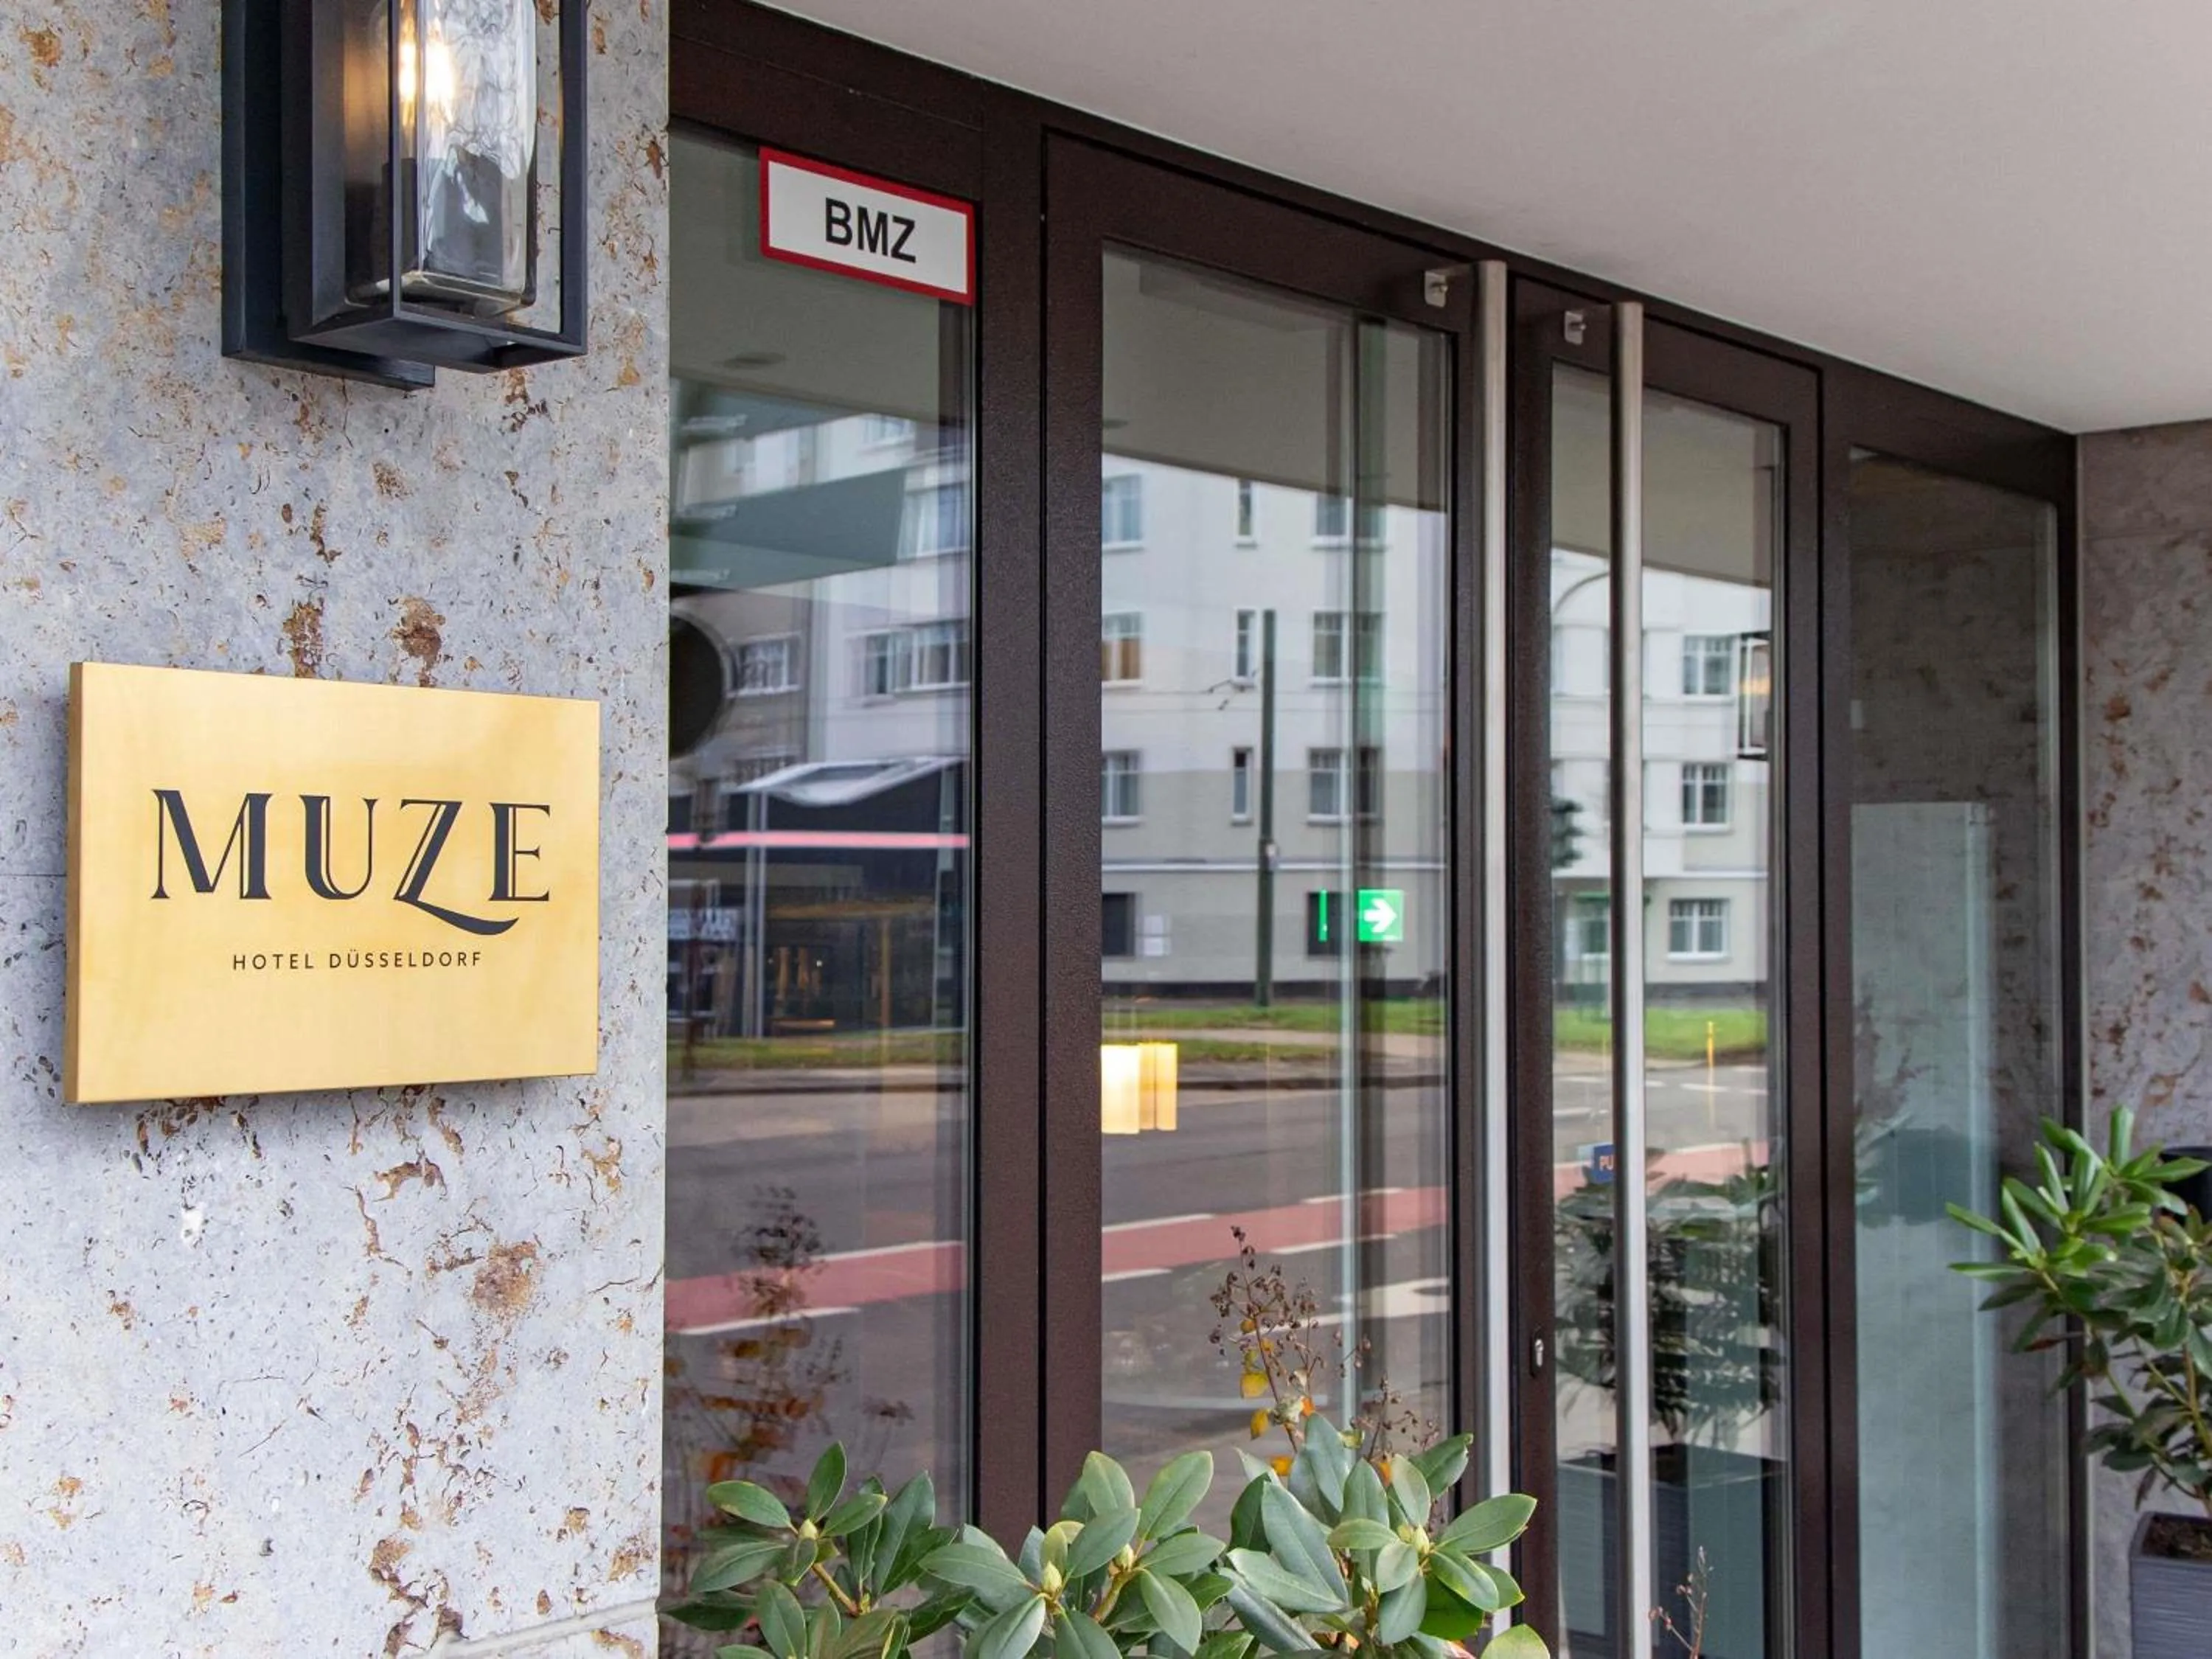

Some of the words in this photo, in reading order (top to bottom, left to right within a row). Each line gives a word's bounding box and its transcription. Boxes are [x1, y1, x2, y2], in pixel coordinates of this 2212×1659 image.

[825, 197, 917, 263] BMZ
[150, 788, 551, 936] MUZE
[232, 953, 314, 971] HOTEL
[329, 948, 482, 970] DÜSSELDORF
